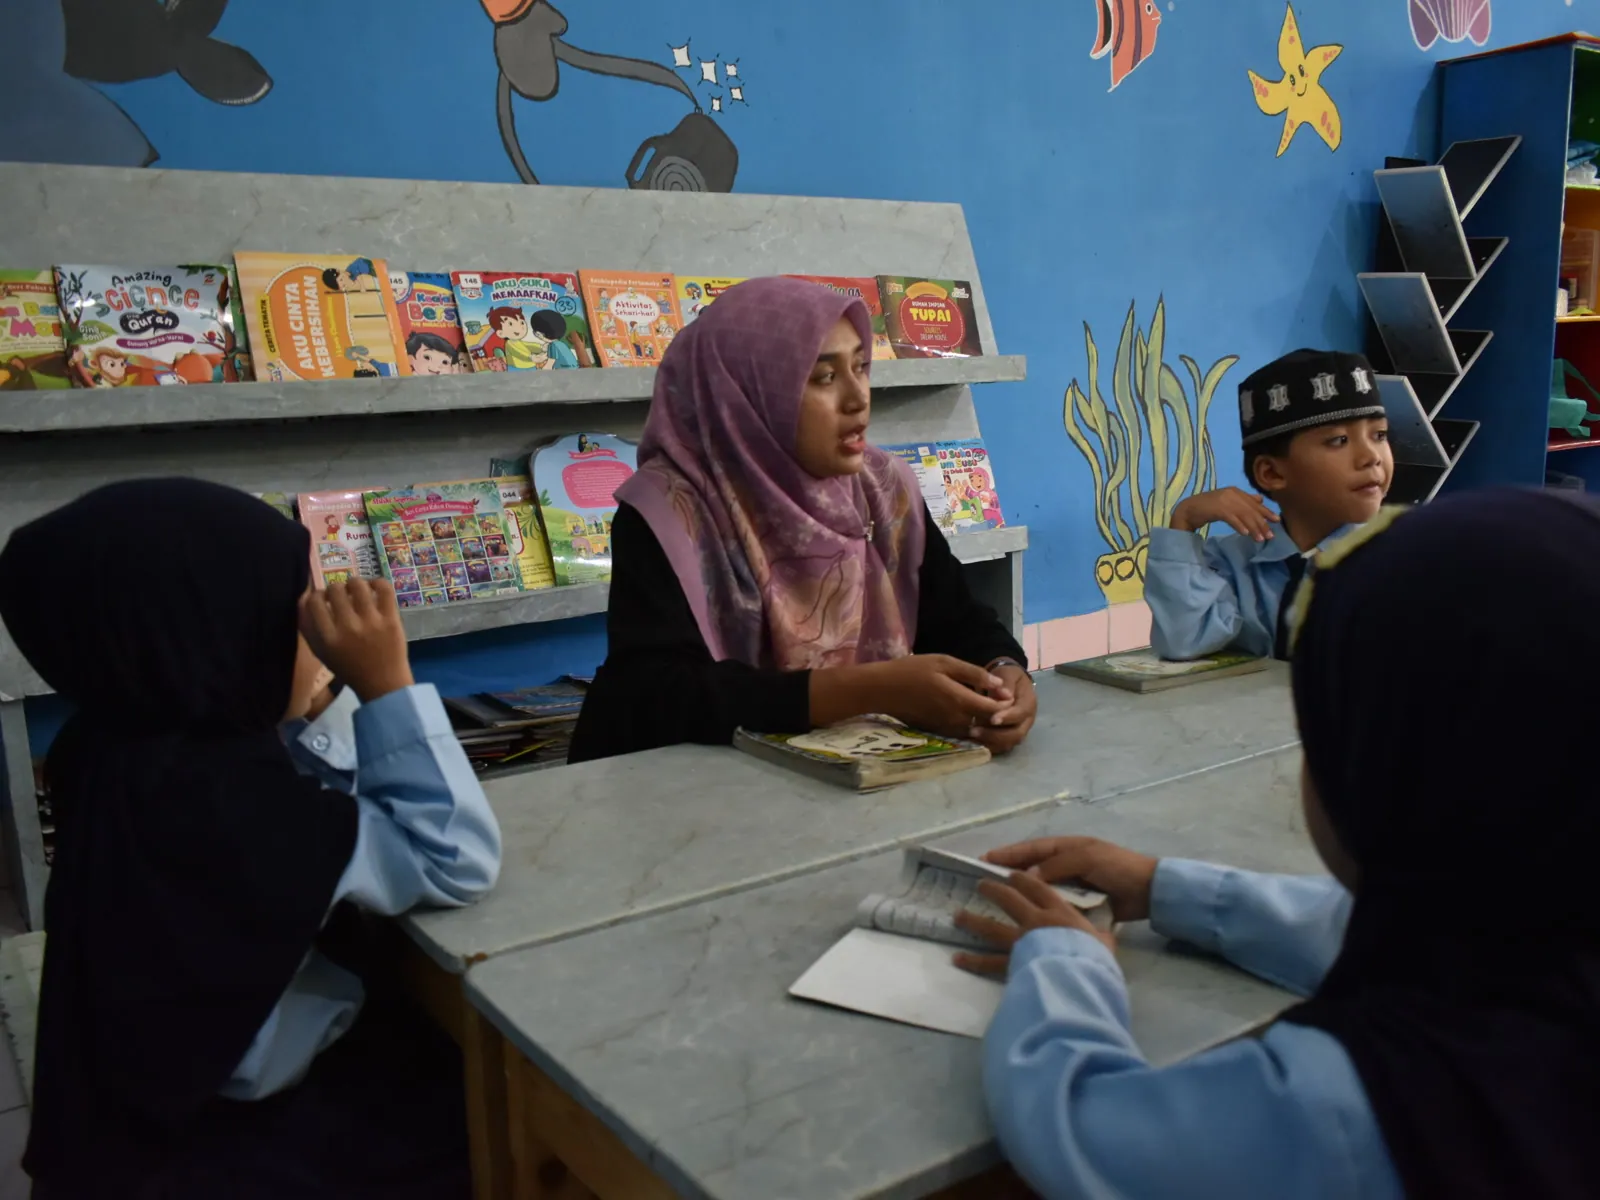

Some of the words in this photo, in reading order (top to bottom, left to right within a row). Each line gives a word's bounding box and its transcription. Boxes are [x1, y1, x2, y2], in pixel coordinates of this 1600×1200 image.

[112, 271, 172, 287] Amazing
[494, 278, 517, 290] AKU
[519, 278, 550, 289] SUKA
[492, 290, 557, 302] MEMAAFKAN
[284, 282, 306, 332] CINTA
[557, 299, 573, 312] 33
[615, 301, 652, 309] Aktivitas
[911, 300, 928, 308] RUMAH
[260, 299, 271, 328] TEMATIK
[614, 309, 656, 317] Sehari-hari
[909, 307, 952, 322] TUPAI
[303, 275, 337, 377] KEBERSIHAN
[264, 329, 276, 353] CERITA
[291, 334, 316, 370] AKU
[502, 491, 516, 499] 044
